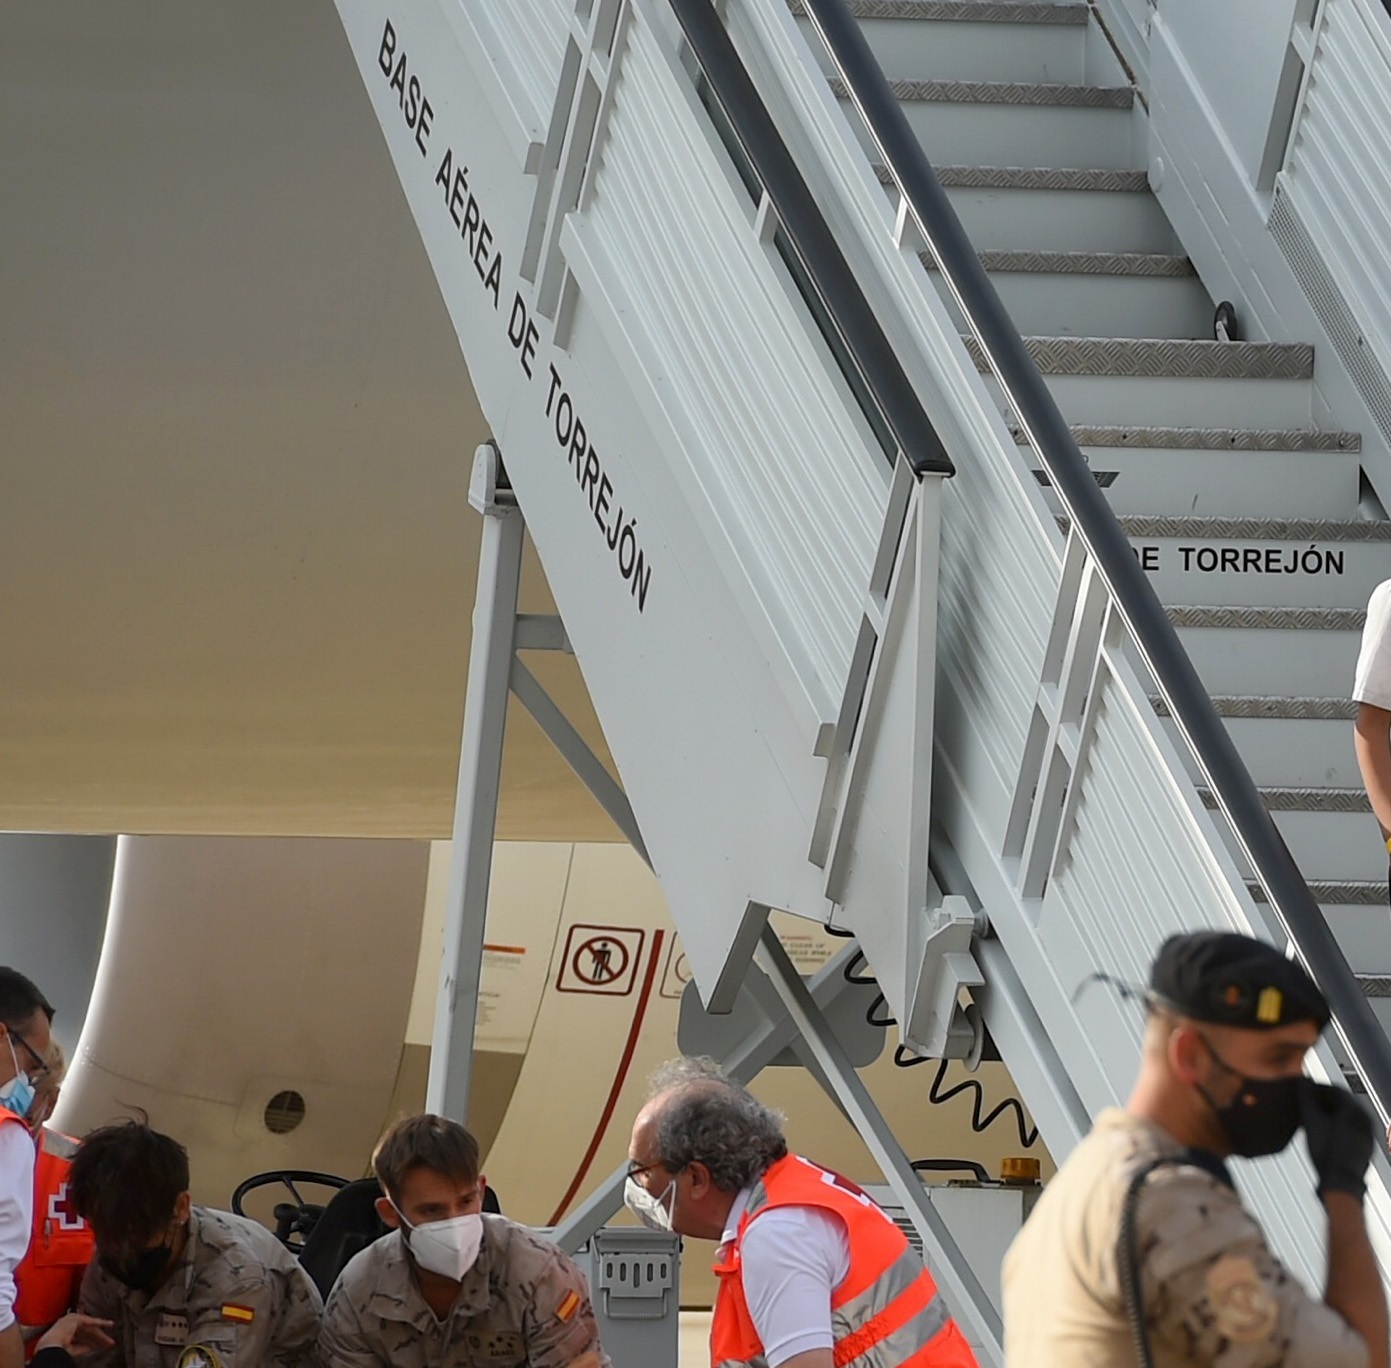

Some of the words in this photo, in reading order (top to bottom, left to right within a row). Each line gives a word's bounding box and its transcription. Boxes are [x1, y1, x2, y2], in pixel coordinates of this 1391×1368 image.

[378, 17, 434, 158] BASE
[435, 147, 502, 311] AÉREA
[508, 290, 540, 381] DE
[545, 361, 652, 614] TORREJÓN
[1178, 545, 1344, 575] TORREJÓN
